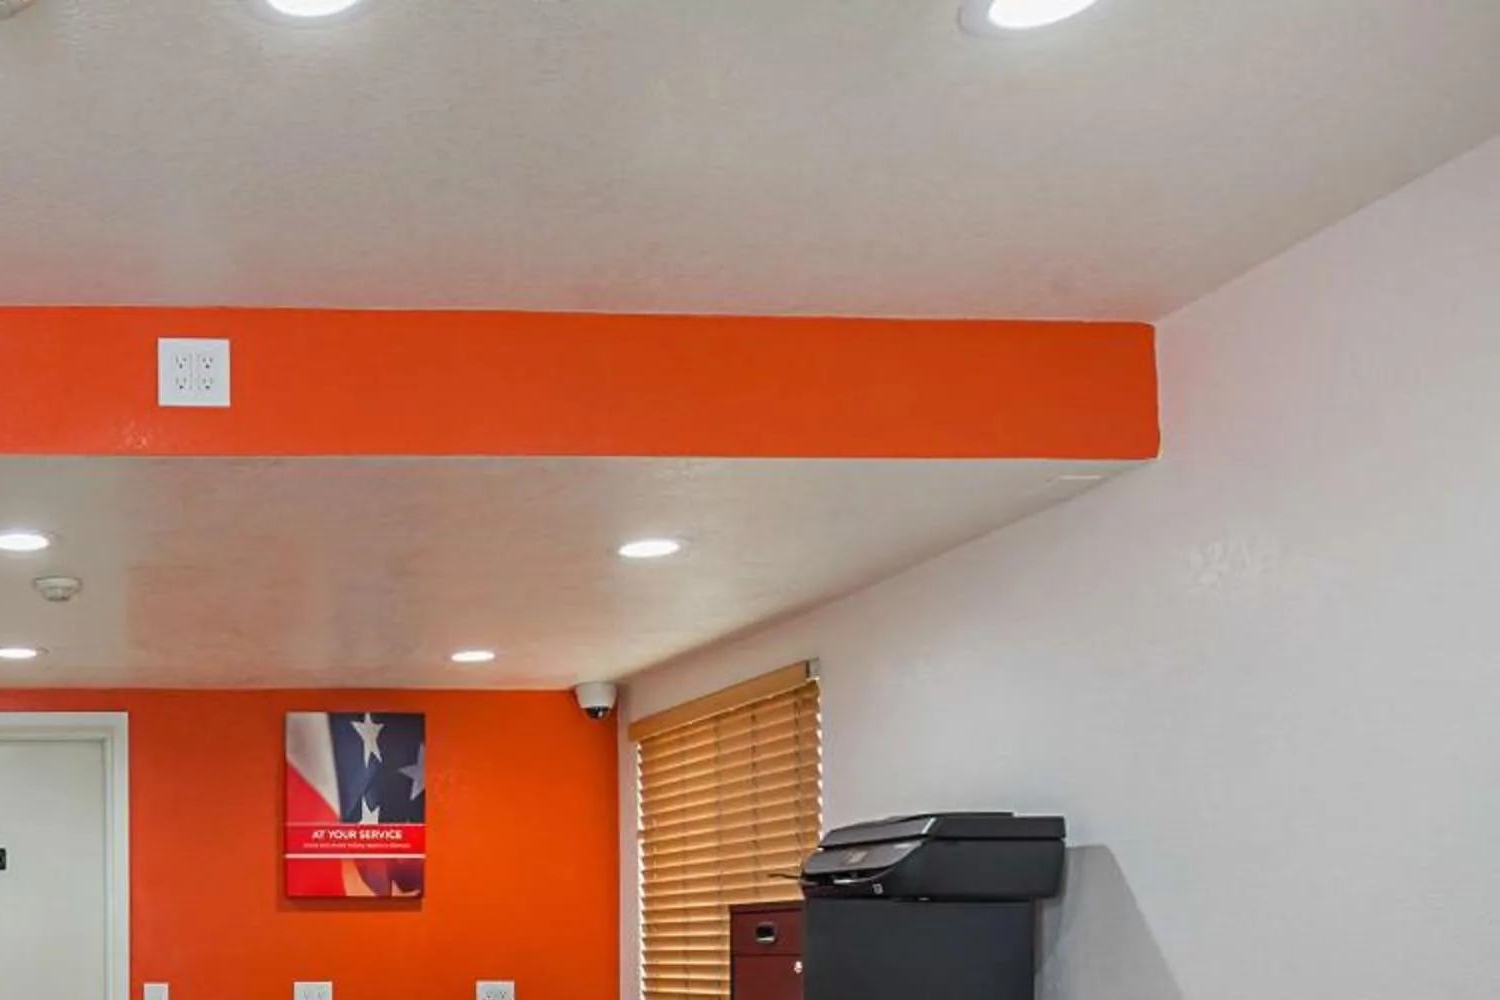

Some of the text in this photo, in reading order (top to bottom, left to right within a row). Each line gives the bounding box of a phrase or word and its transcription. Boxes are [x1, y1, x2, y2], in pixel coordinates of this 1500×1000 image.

[312, 829, 403, 840] AT YOUR SERVICE
